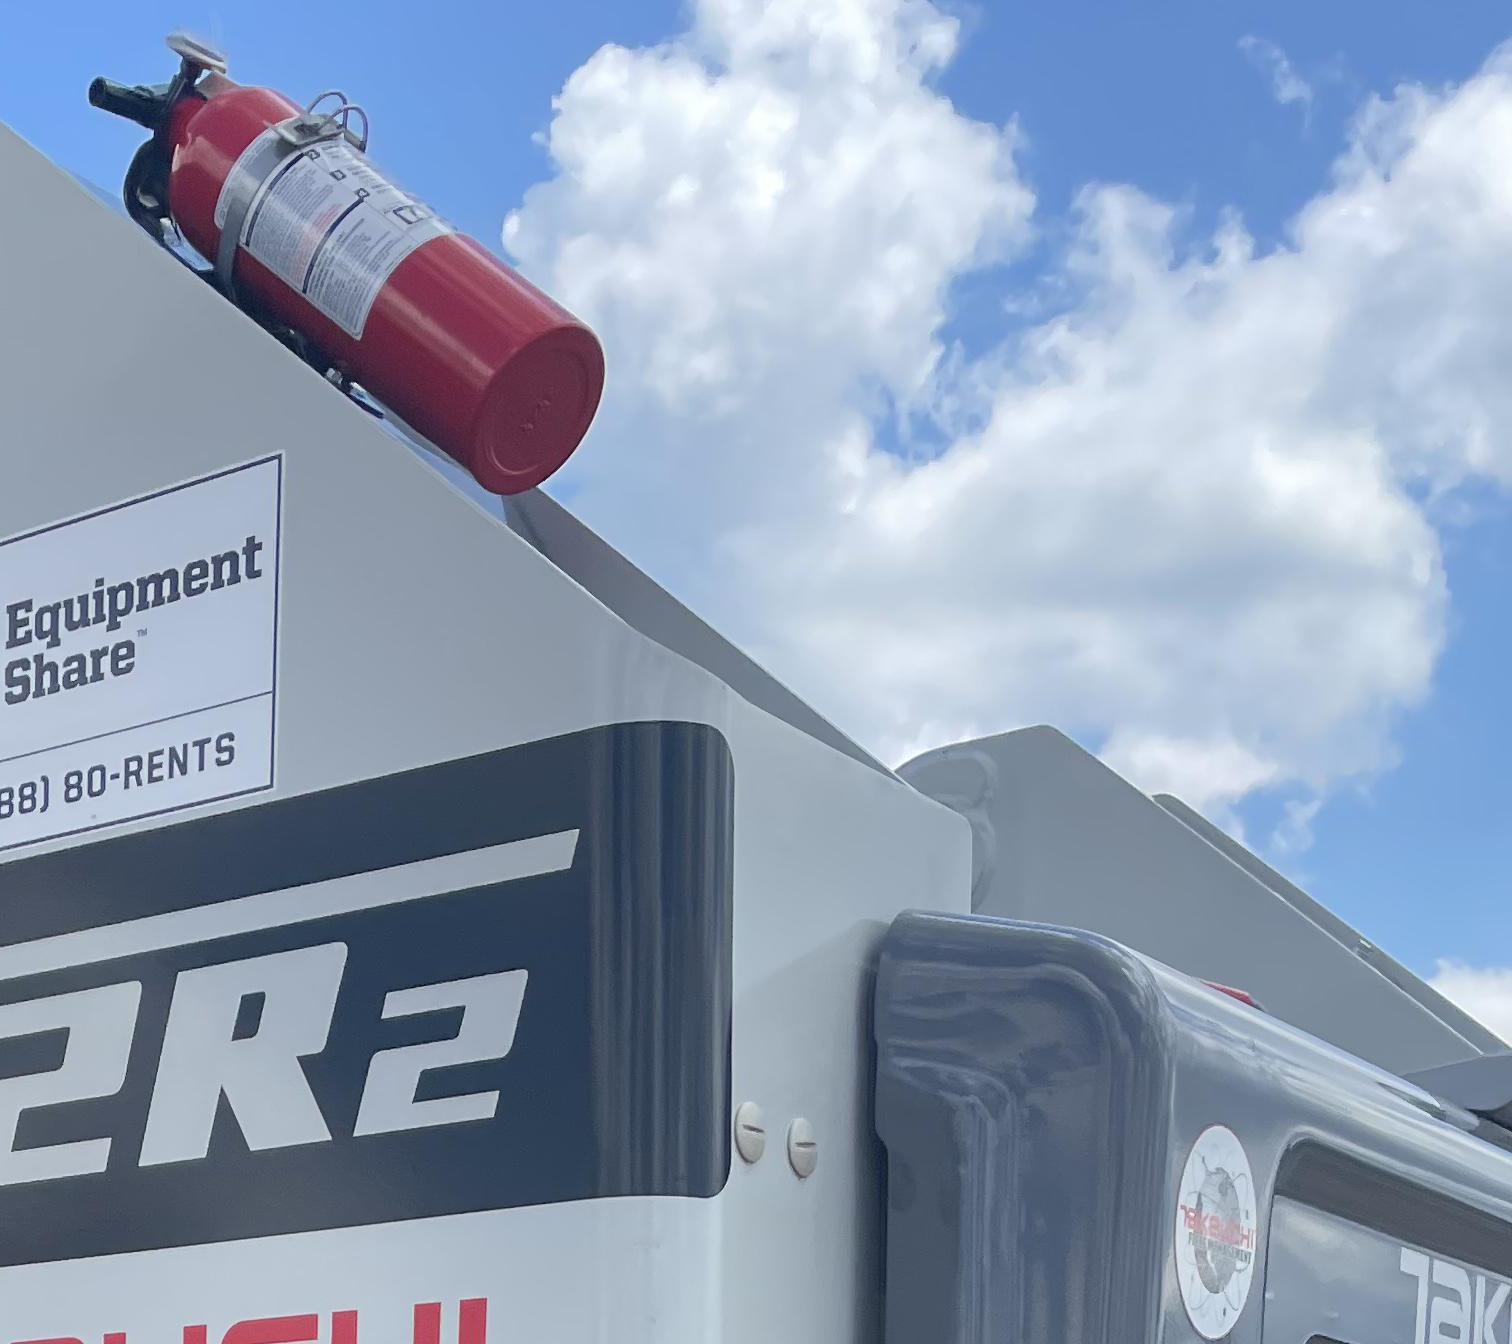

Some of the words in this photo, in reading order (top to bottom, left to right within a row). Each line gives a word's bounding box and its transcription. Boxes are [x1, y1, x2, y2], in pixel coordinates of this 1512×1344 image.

[5, 535, 263, 649] Equipment
[4, 639, 136, 706] Share
[64, 731, 236, 803] 80-RENTS
